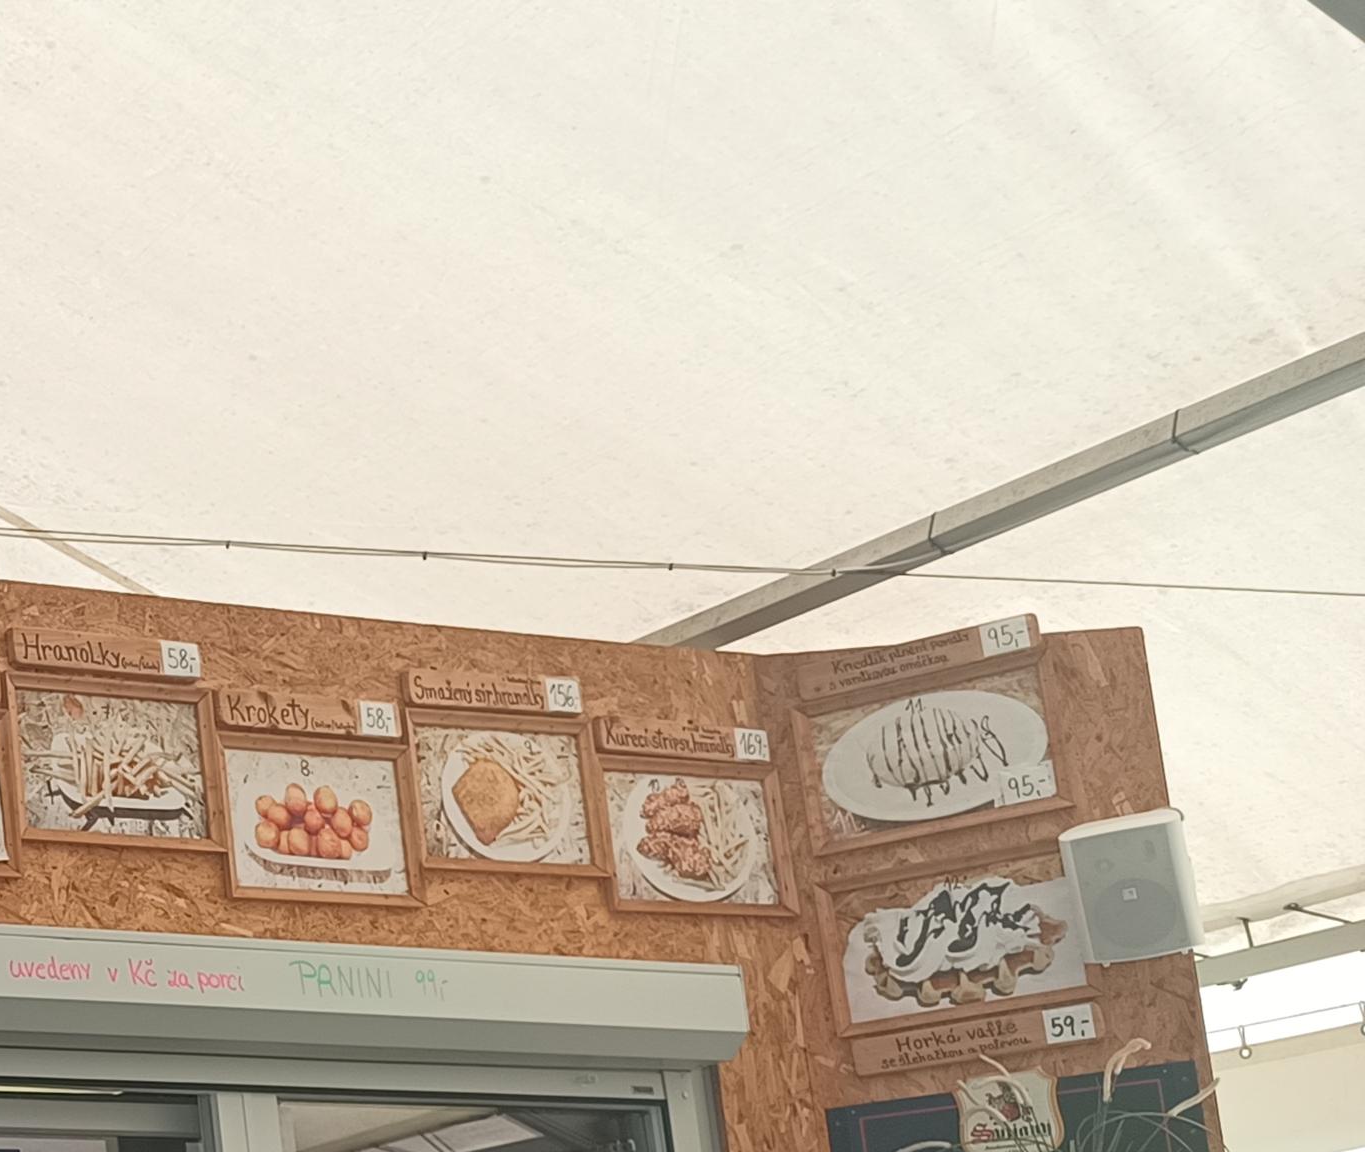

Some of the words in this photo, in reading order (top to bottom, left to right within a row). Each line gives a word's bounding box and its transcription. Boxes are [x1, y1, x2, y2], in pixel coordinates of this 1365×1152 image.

[987, 624, 1025, 649] 95,-
[168, 647, 197, 674] 58,-
[227, 694, 309, 729] Krokety
[365, 706, 393, 733] 58,-
[1007, 773, 1048, 798] 95,-
[9, 957, 92, 983] uvedeny
[129, 957, 159, 989] Kč
[197, 966, 246, 996] porci
[290, 960, 395, 1000] PANINI
[895, 1027, 961, 1053] Horká
[1050, 1014, 1090, 1038] 59,-
